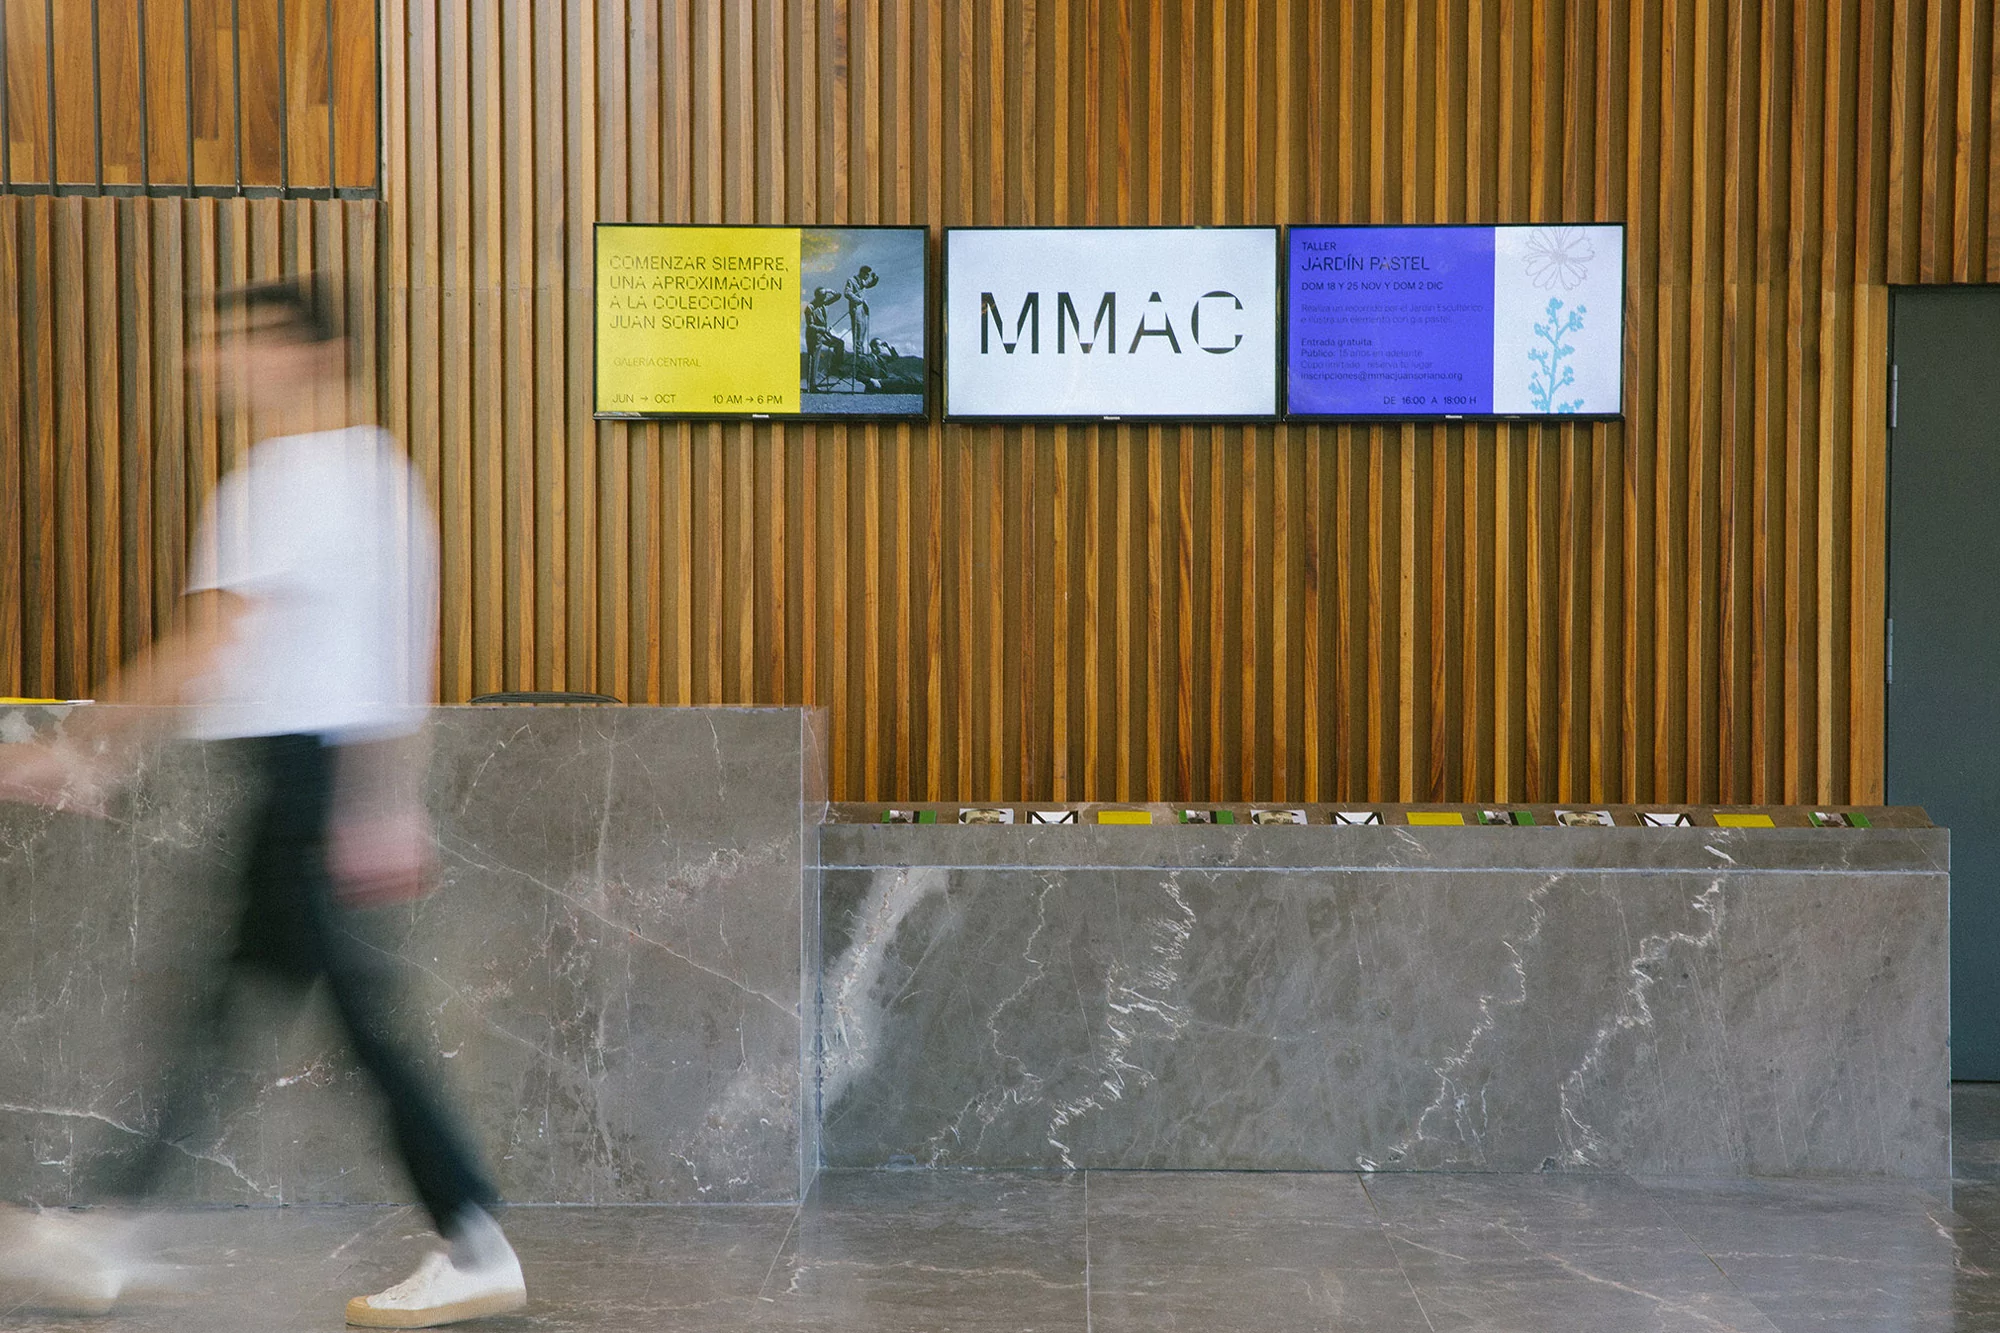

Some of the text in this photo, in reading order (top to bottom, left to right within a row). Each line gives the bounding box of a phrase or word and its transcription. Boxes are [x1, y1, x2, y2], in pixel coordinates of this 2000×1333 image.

[1302, 241, 1337, 251] TALLER
[610, 256, 789, 272] COMENZAR SIEMPRE,
[1301, 253, 1430, 271] JARDÍN PASTEL
[610, 273, 782, 290] UNA APROXIMACIÓN
[1302, 281, 1444, 290] DOM 18 Y 25 NOV Y DOM 2 DIC
[610, 293, 753, 310] A LA COLECCIÓN
[610, 315, 739, 330] JUAN SORIANO
[980, 290, 1244, 355] MMAC
[1301, 338, 1335, 346] Entrada
[656, 356, 701, 367] CENTRAL
[612, 394, 676, 404] JUN OCT
[713, 395, 783, 404] 10 AM 6 PM
[1402, 396, 1425, 404] 16:00
